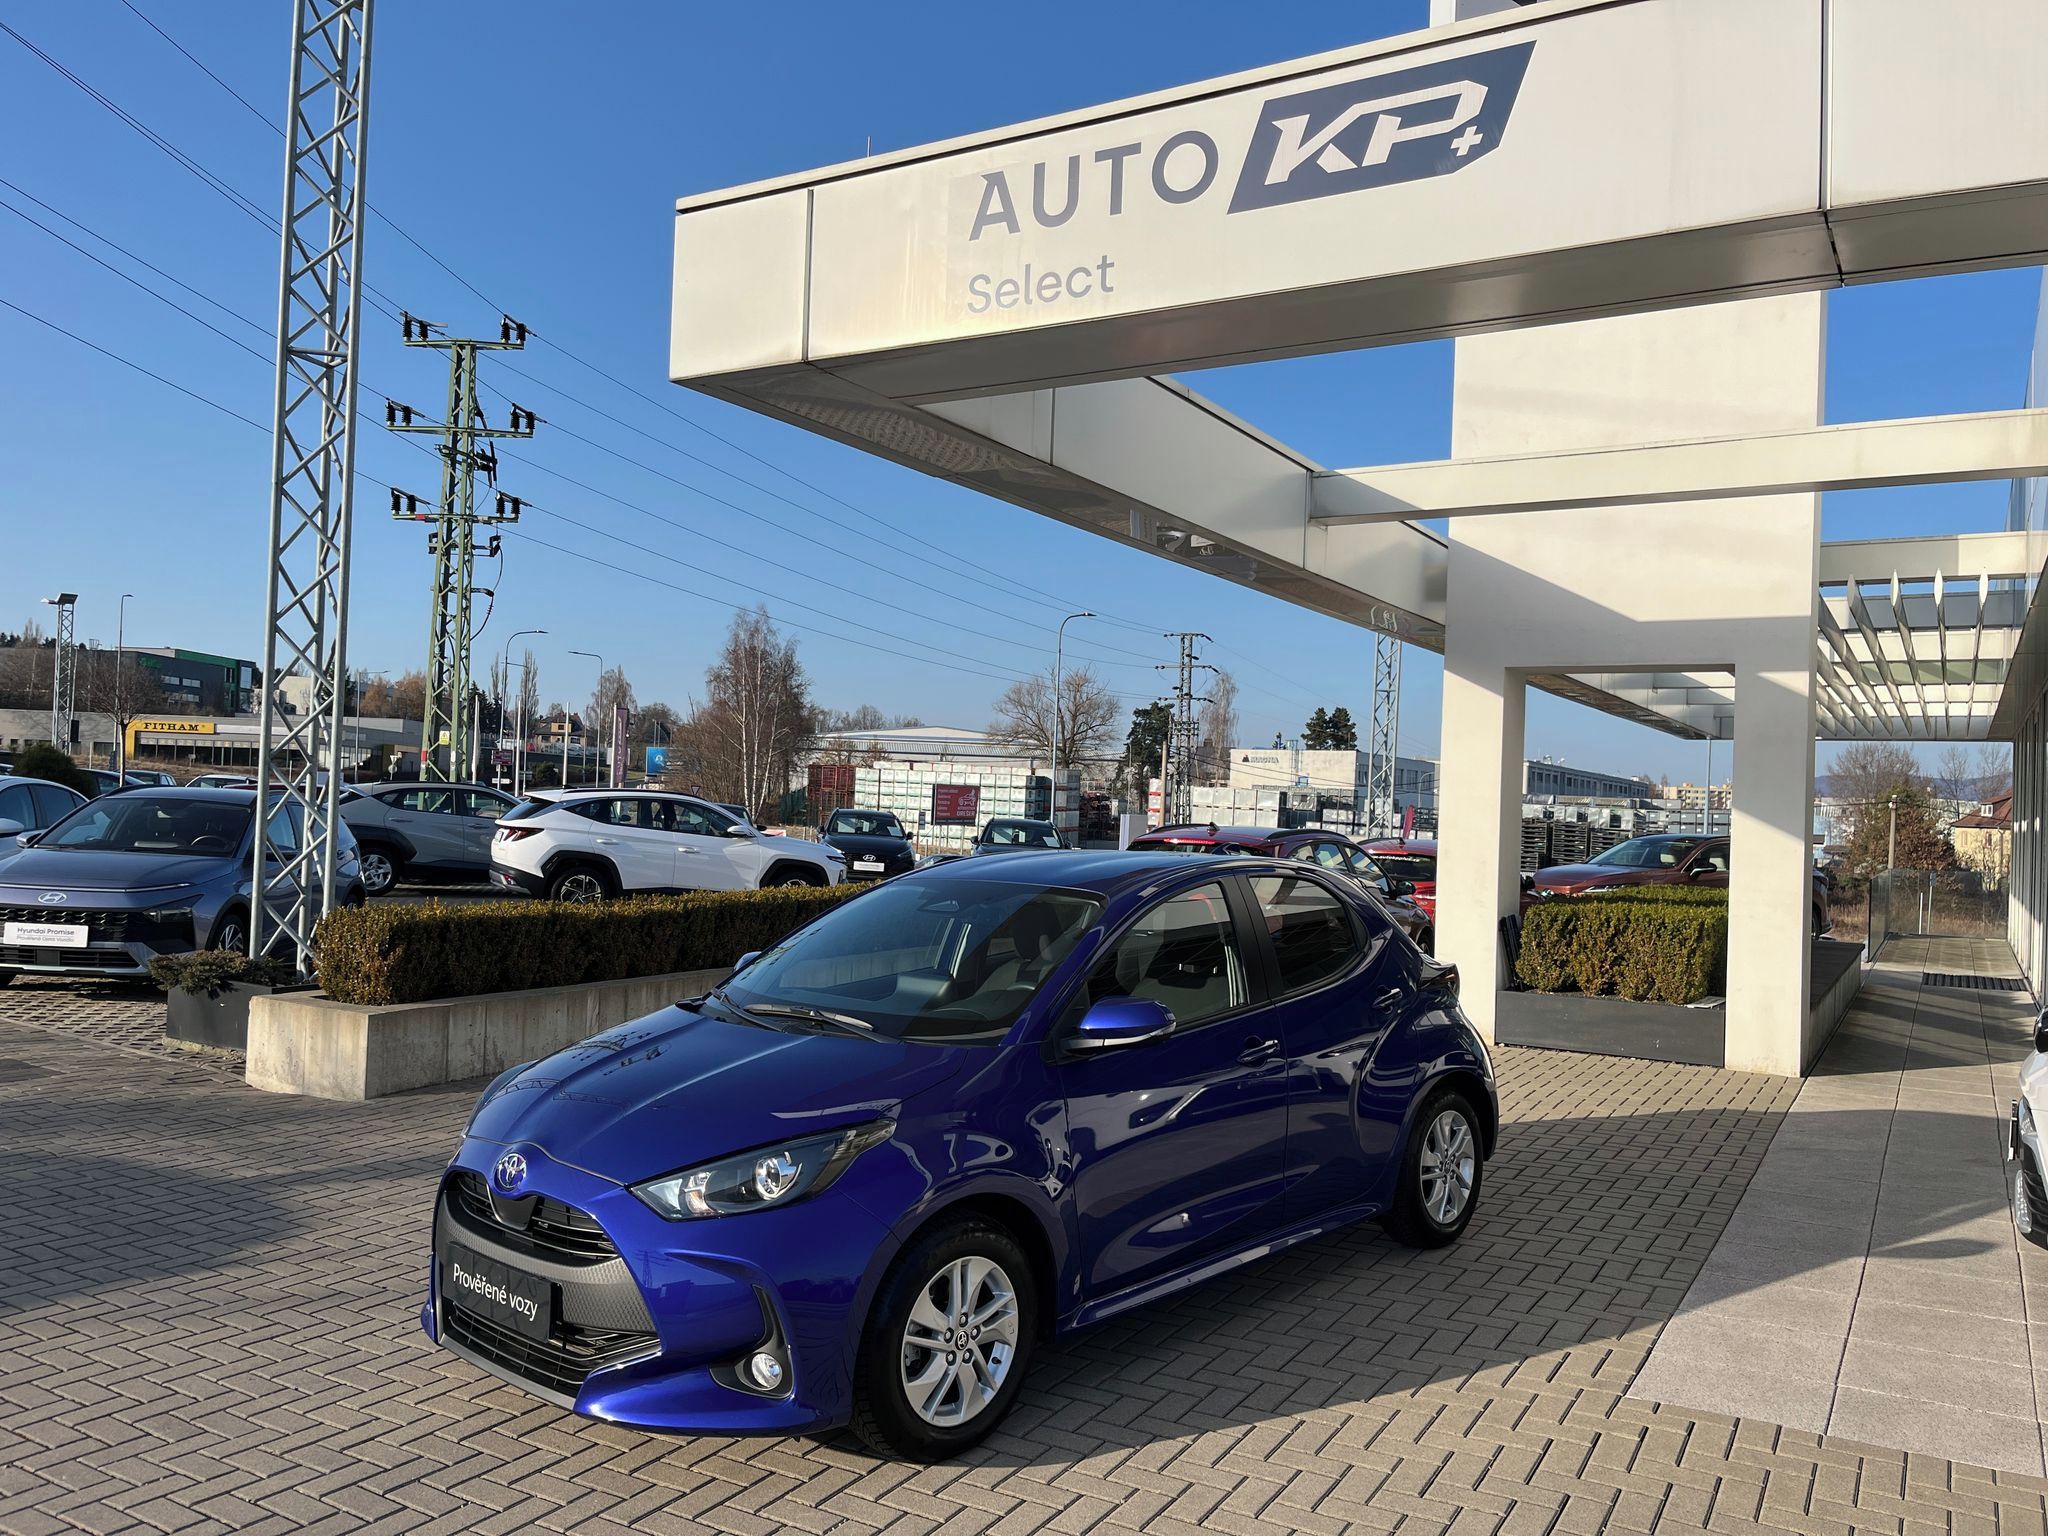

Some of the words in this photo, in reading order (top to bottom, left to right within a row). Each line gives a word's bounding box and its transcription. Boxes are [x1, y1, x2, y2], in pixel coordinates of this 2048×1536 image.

[969, 130, 1218, 241] AUTO
[968, 255, 1115, 314] Select
[144, 722, 199, 731] FITHAM
[17, 927, 46, 935] Hyundai
[47, 928, 75, 936] Promise
[453, 1263, 507, 1305] Prověřené
[509, 1293, 538, 1322] vozy
